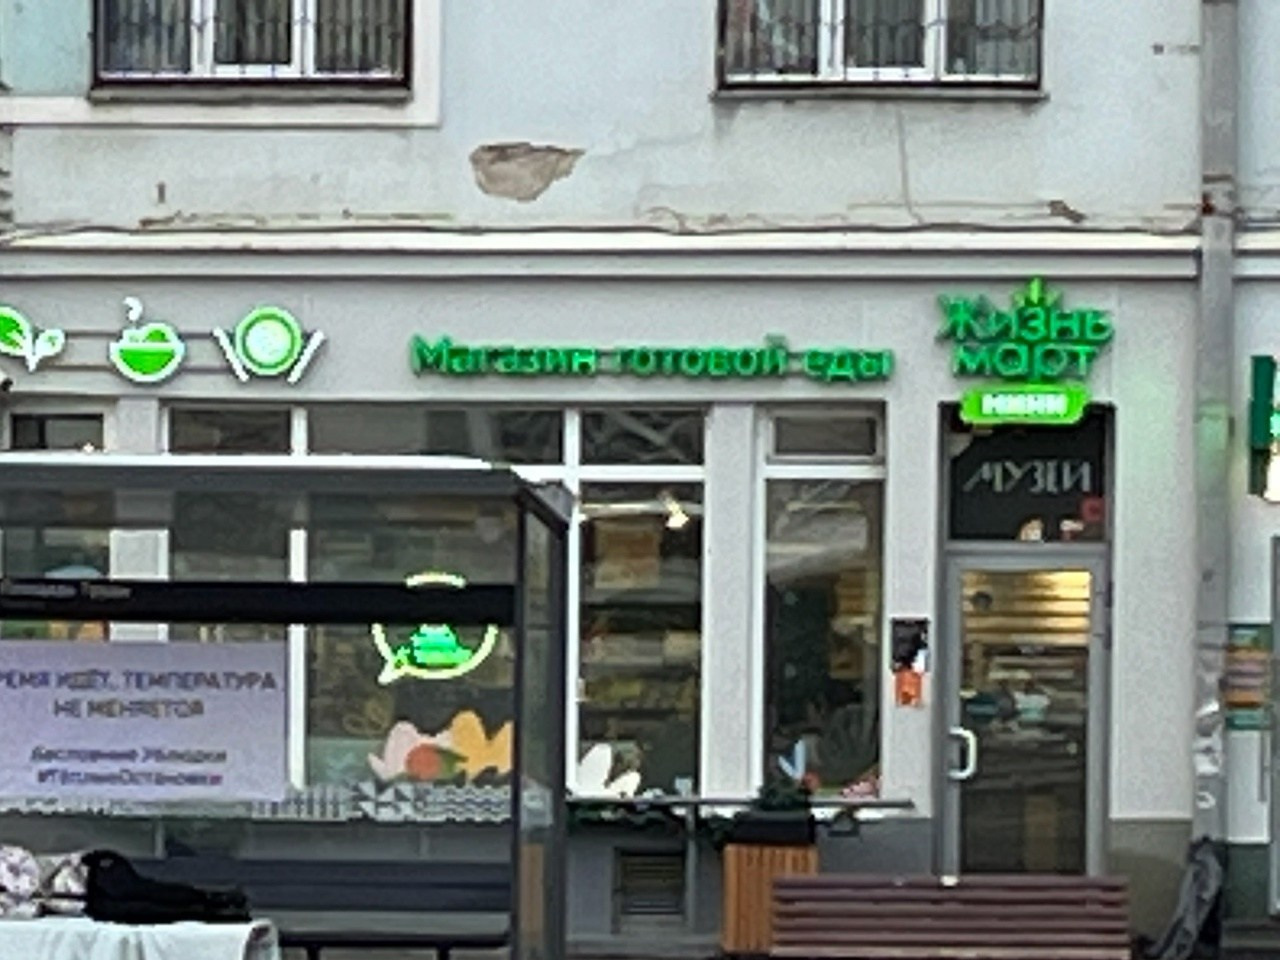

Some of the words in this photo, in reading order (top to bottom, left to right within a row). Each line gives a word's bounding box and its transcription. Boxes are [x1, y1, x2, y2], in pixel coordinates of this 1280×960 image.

[937, 295, 1114, 341] Жизнь
[410, 333, 598, 376] Магазин
[610, 335, 790, 376] готовой
[803, 349, 894, 382] еды
[122, 670, 276, 690] ТЕМПЕРАТУРА
[53, 699, 82, 719] НЕ
[86, 699, 204, 720] МЕНЯЕТСЯ
